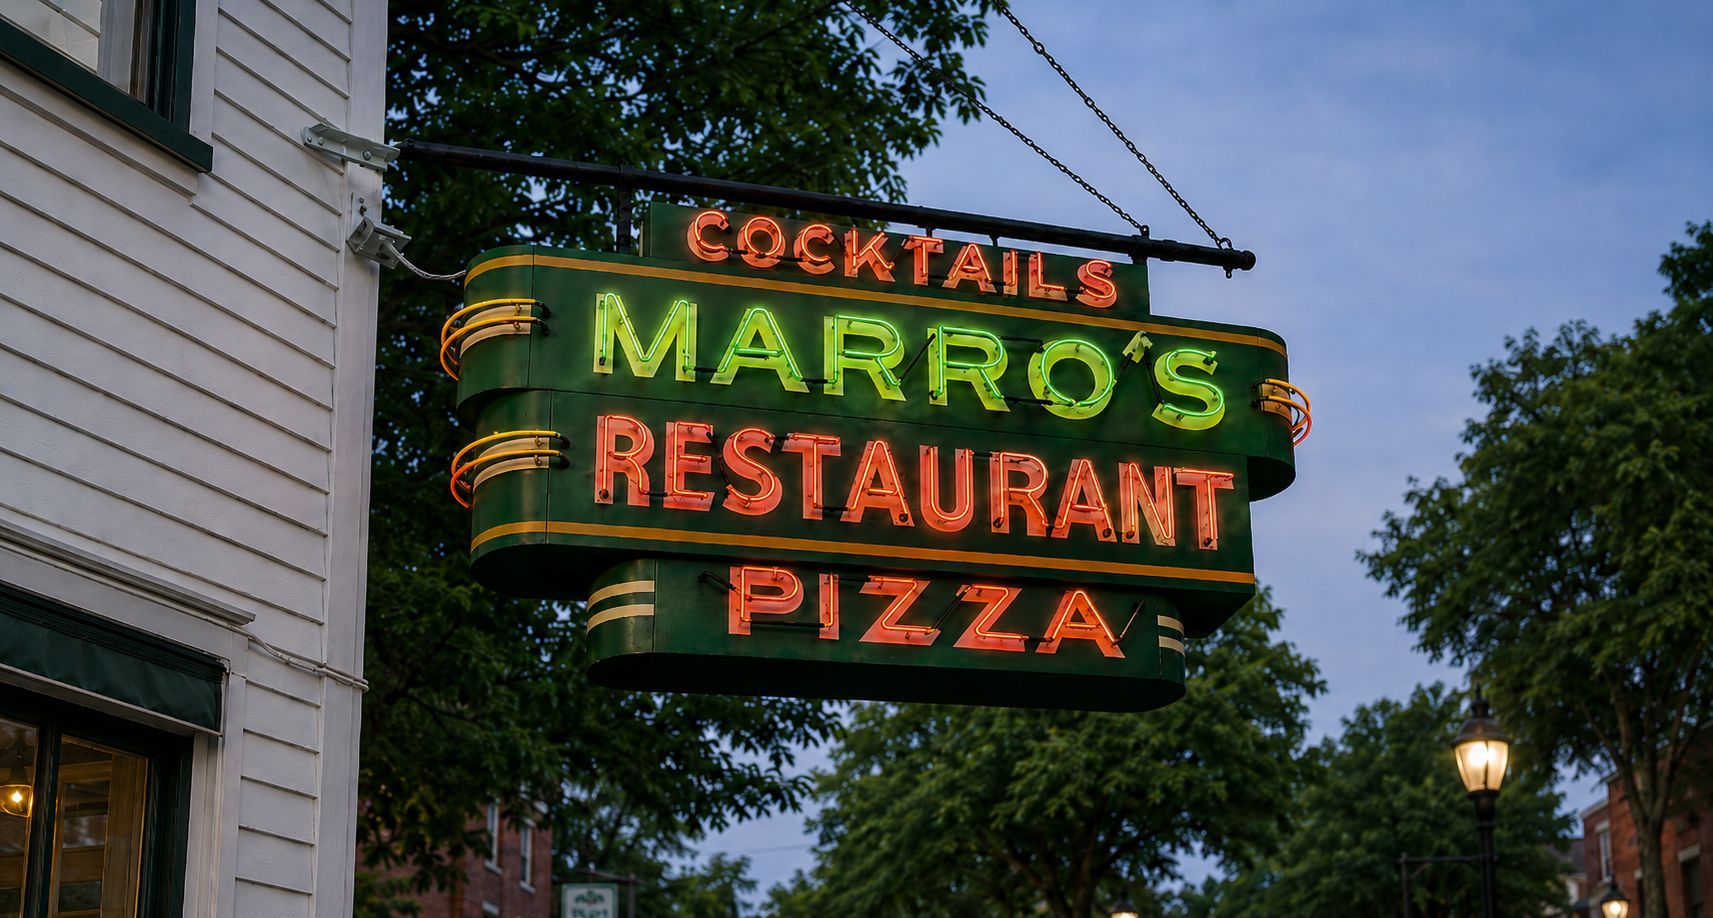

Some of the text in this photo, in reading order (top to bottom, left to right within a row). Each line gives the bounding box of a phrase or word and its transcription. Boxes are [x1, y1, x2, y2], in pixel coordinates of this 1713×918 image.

[686, 209, 1118, 308] COCKTAILS
[593, 292, 1226, 431] MARRO'S
[593, 414, 1235, 551] RESTAURANT
[728, 564, 1126, 659] PIZZA
